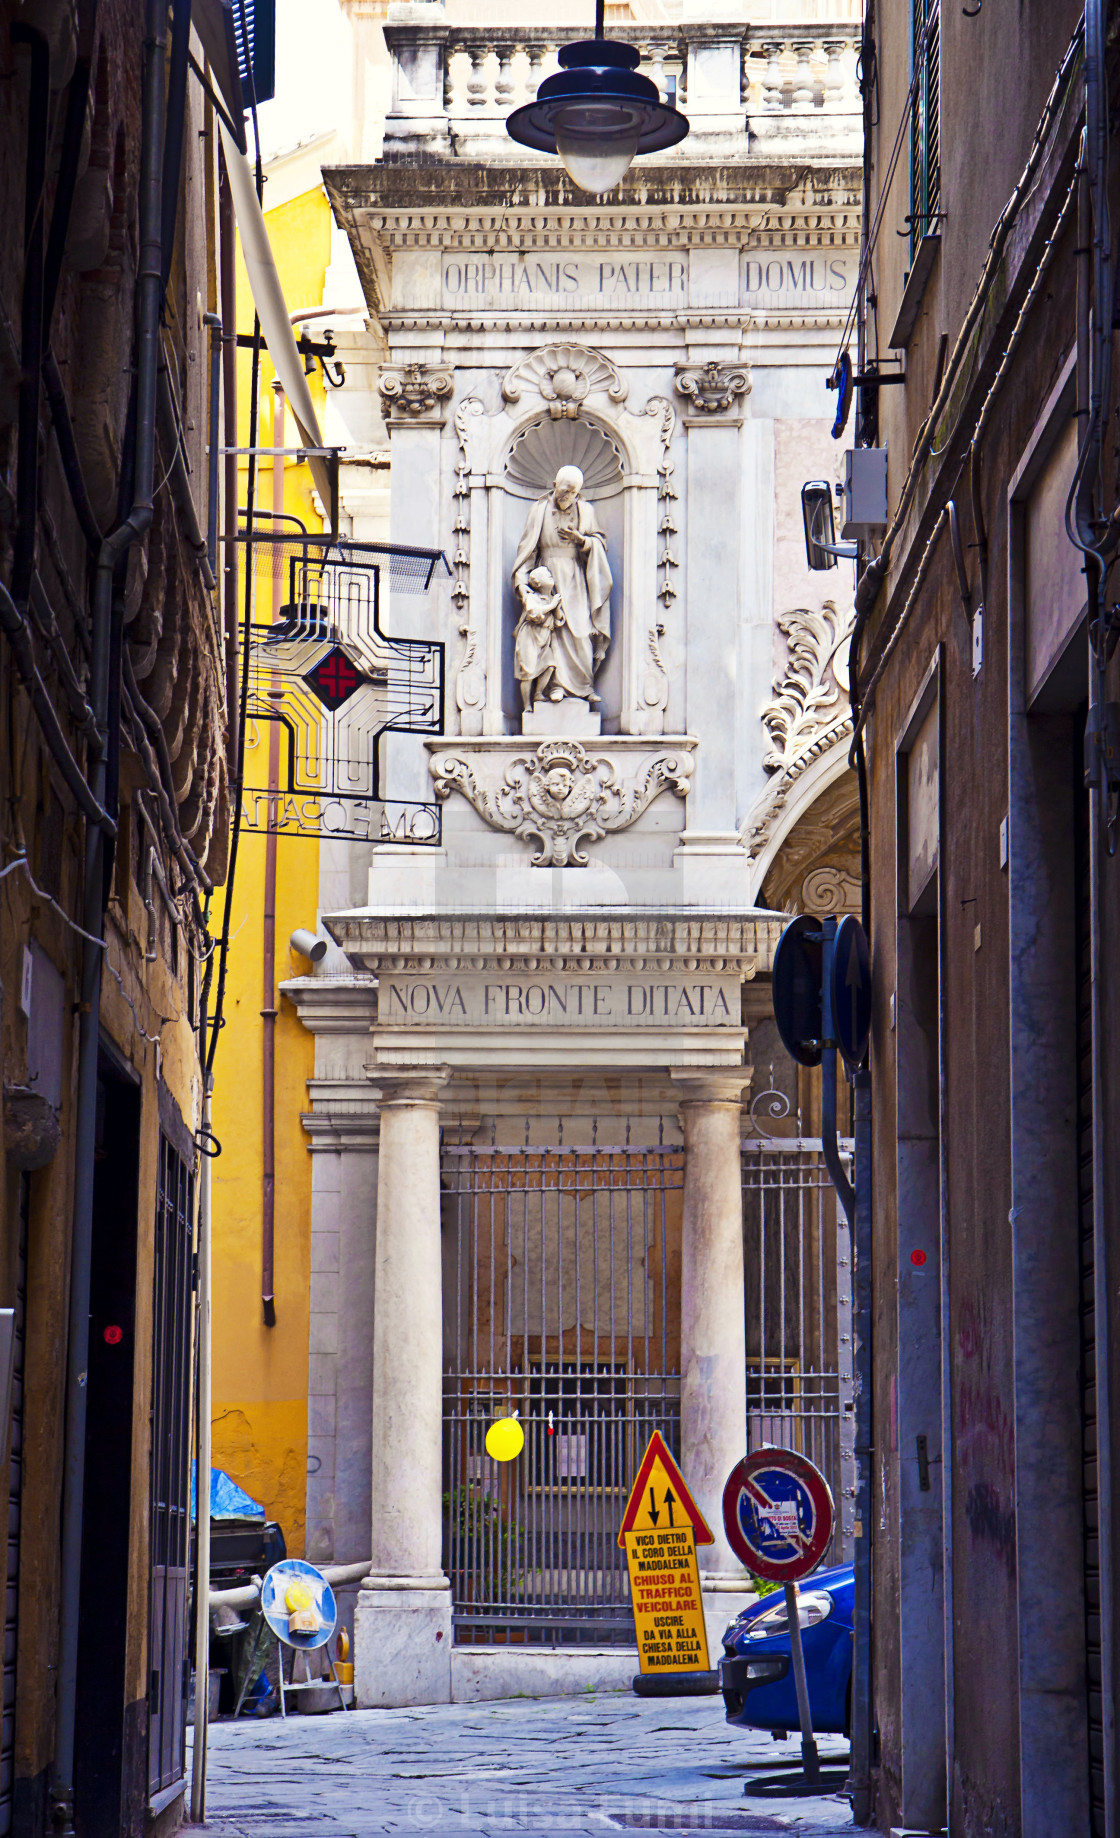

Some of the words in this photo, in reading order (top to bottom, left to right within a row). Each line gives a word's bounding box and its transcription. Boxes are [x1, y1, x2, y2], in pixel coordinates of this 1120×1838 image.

[444, 262, 579, 294] ORPHANIS
[598, 261, 685, 293] PATER
[745, 259, 848, 292] DOMUS
[389, 984, 467, 1015] NOVA
[484, 985, 612, 1015] FRONTE
[626, 985, 731, 1016] DITATA
[635, 1534, 655, 1547] VICO
[657, 1532, 687, 1545] DIETRO
[632, 1549, 640, 1559] IL
[642, 1546, 665, 1559] CORO
[667, 1544, 693, 1557] DELLA
[638, 1558, 690, 1571] MADDALENA
[633, 1573, 675, 1587] CHIUSO
[680, 1572, 694, 1584] AL
[638, 1586, 693, 1600] TRAFFICO
[636, 1599, 698, 1613] VEICOLARE
[653, 1615, 684, 1628] USCIRE
[643, 1629, 656, 1641] DA
[658, 1628, 673, 1640] VIA
[676, 1628, 697, 1639] ALLA
[642, 1641, 673, 1654] CHIESA
[675, 1640, 702, 1652] DELLA
[647, 1653, 700, 1666] MADDALENA
